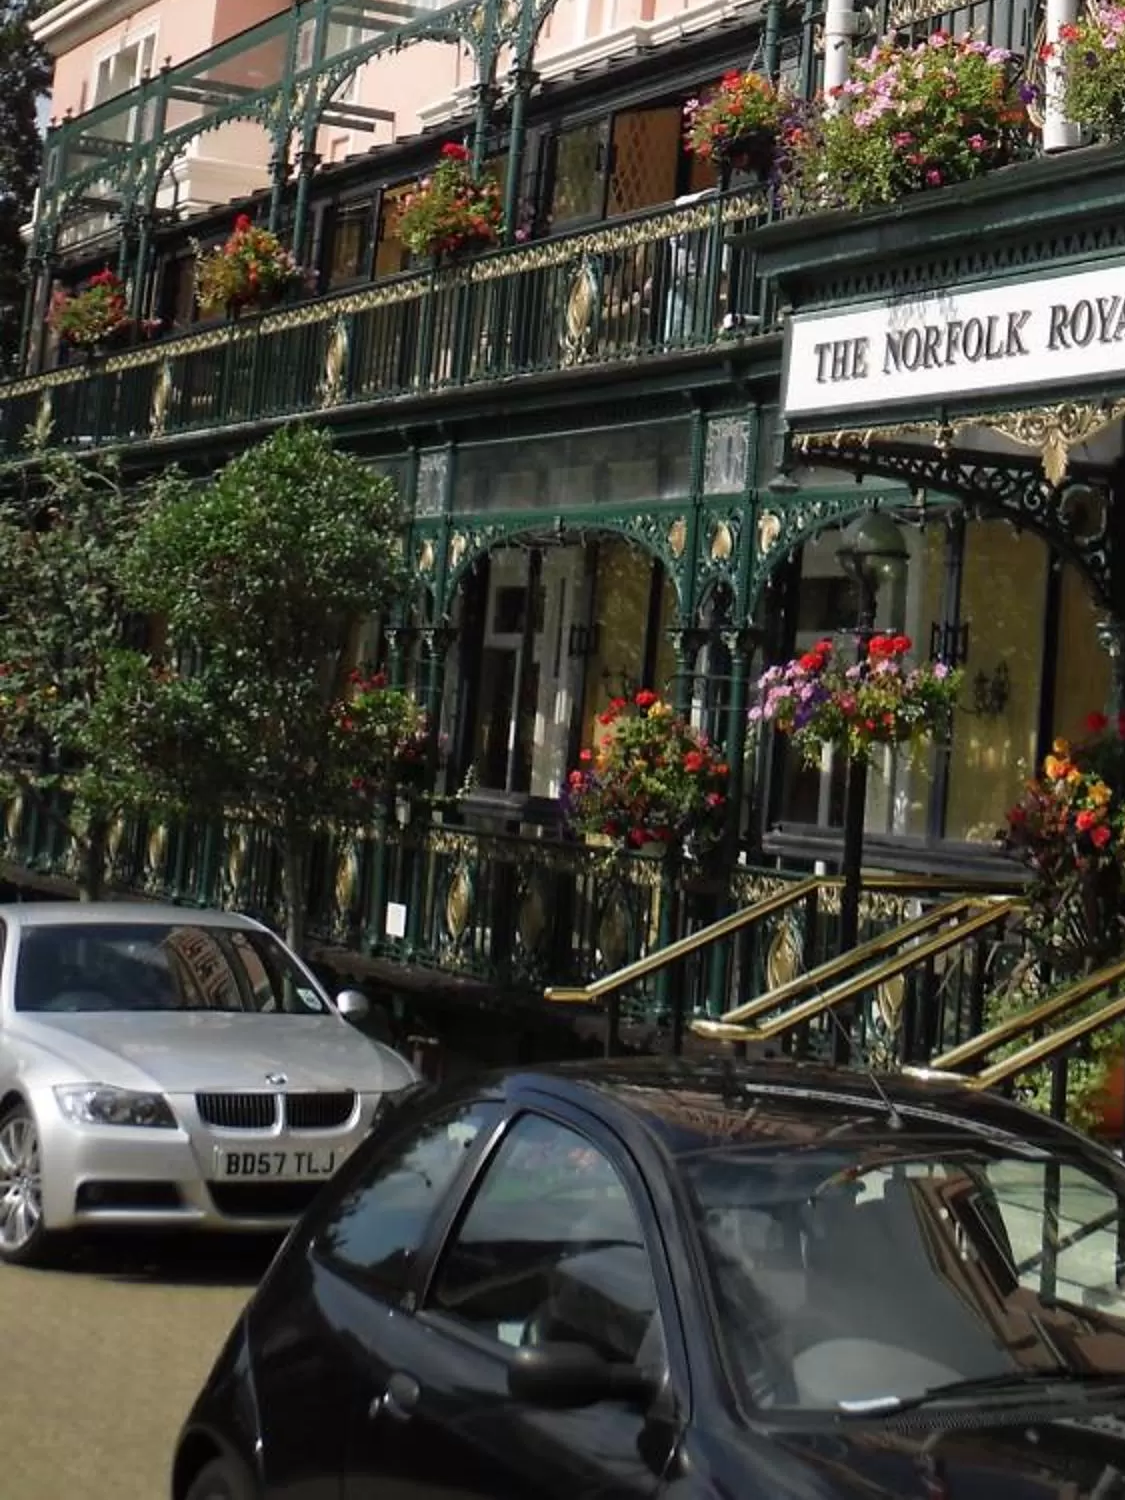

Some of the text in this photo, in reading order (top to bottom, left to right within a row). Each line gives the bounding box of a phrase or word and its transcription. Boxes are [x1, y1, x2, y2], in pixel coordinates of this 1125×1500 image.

[814, 336, 870, 383] THE
[882, 309, 1033, 375] NORFOLK
[226, 1151, 336, 1175] BD57 TLJ
